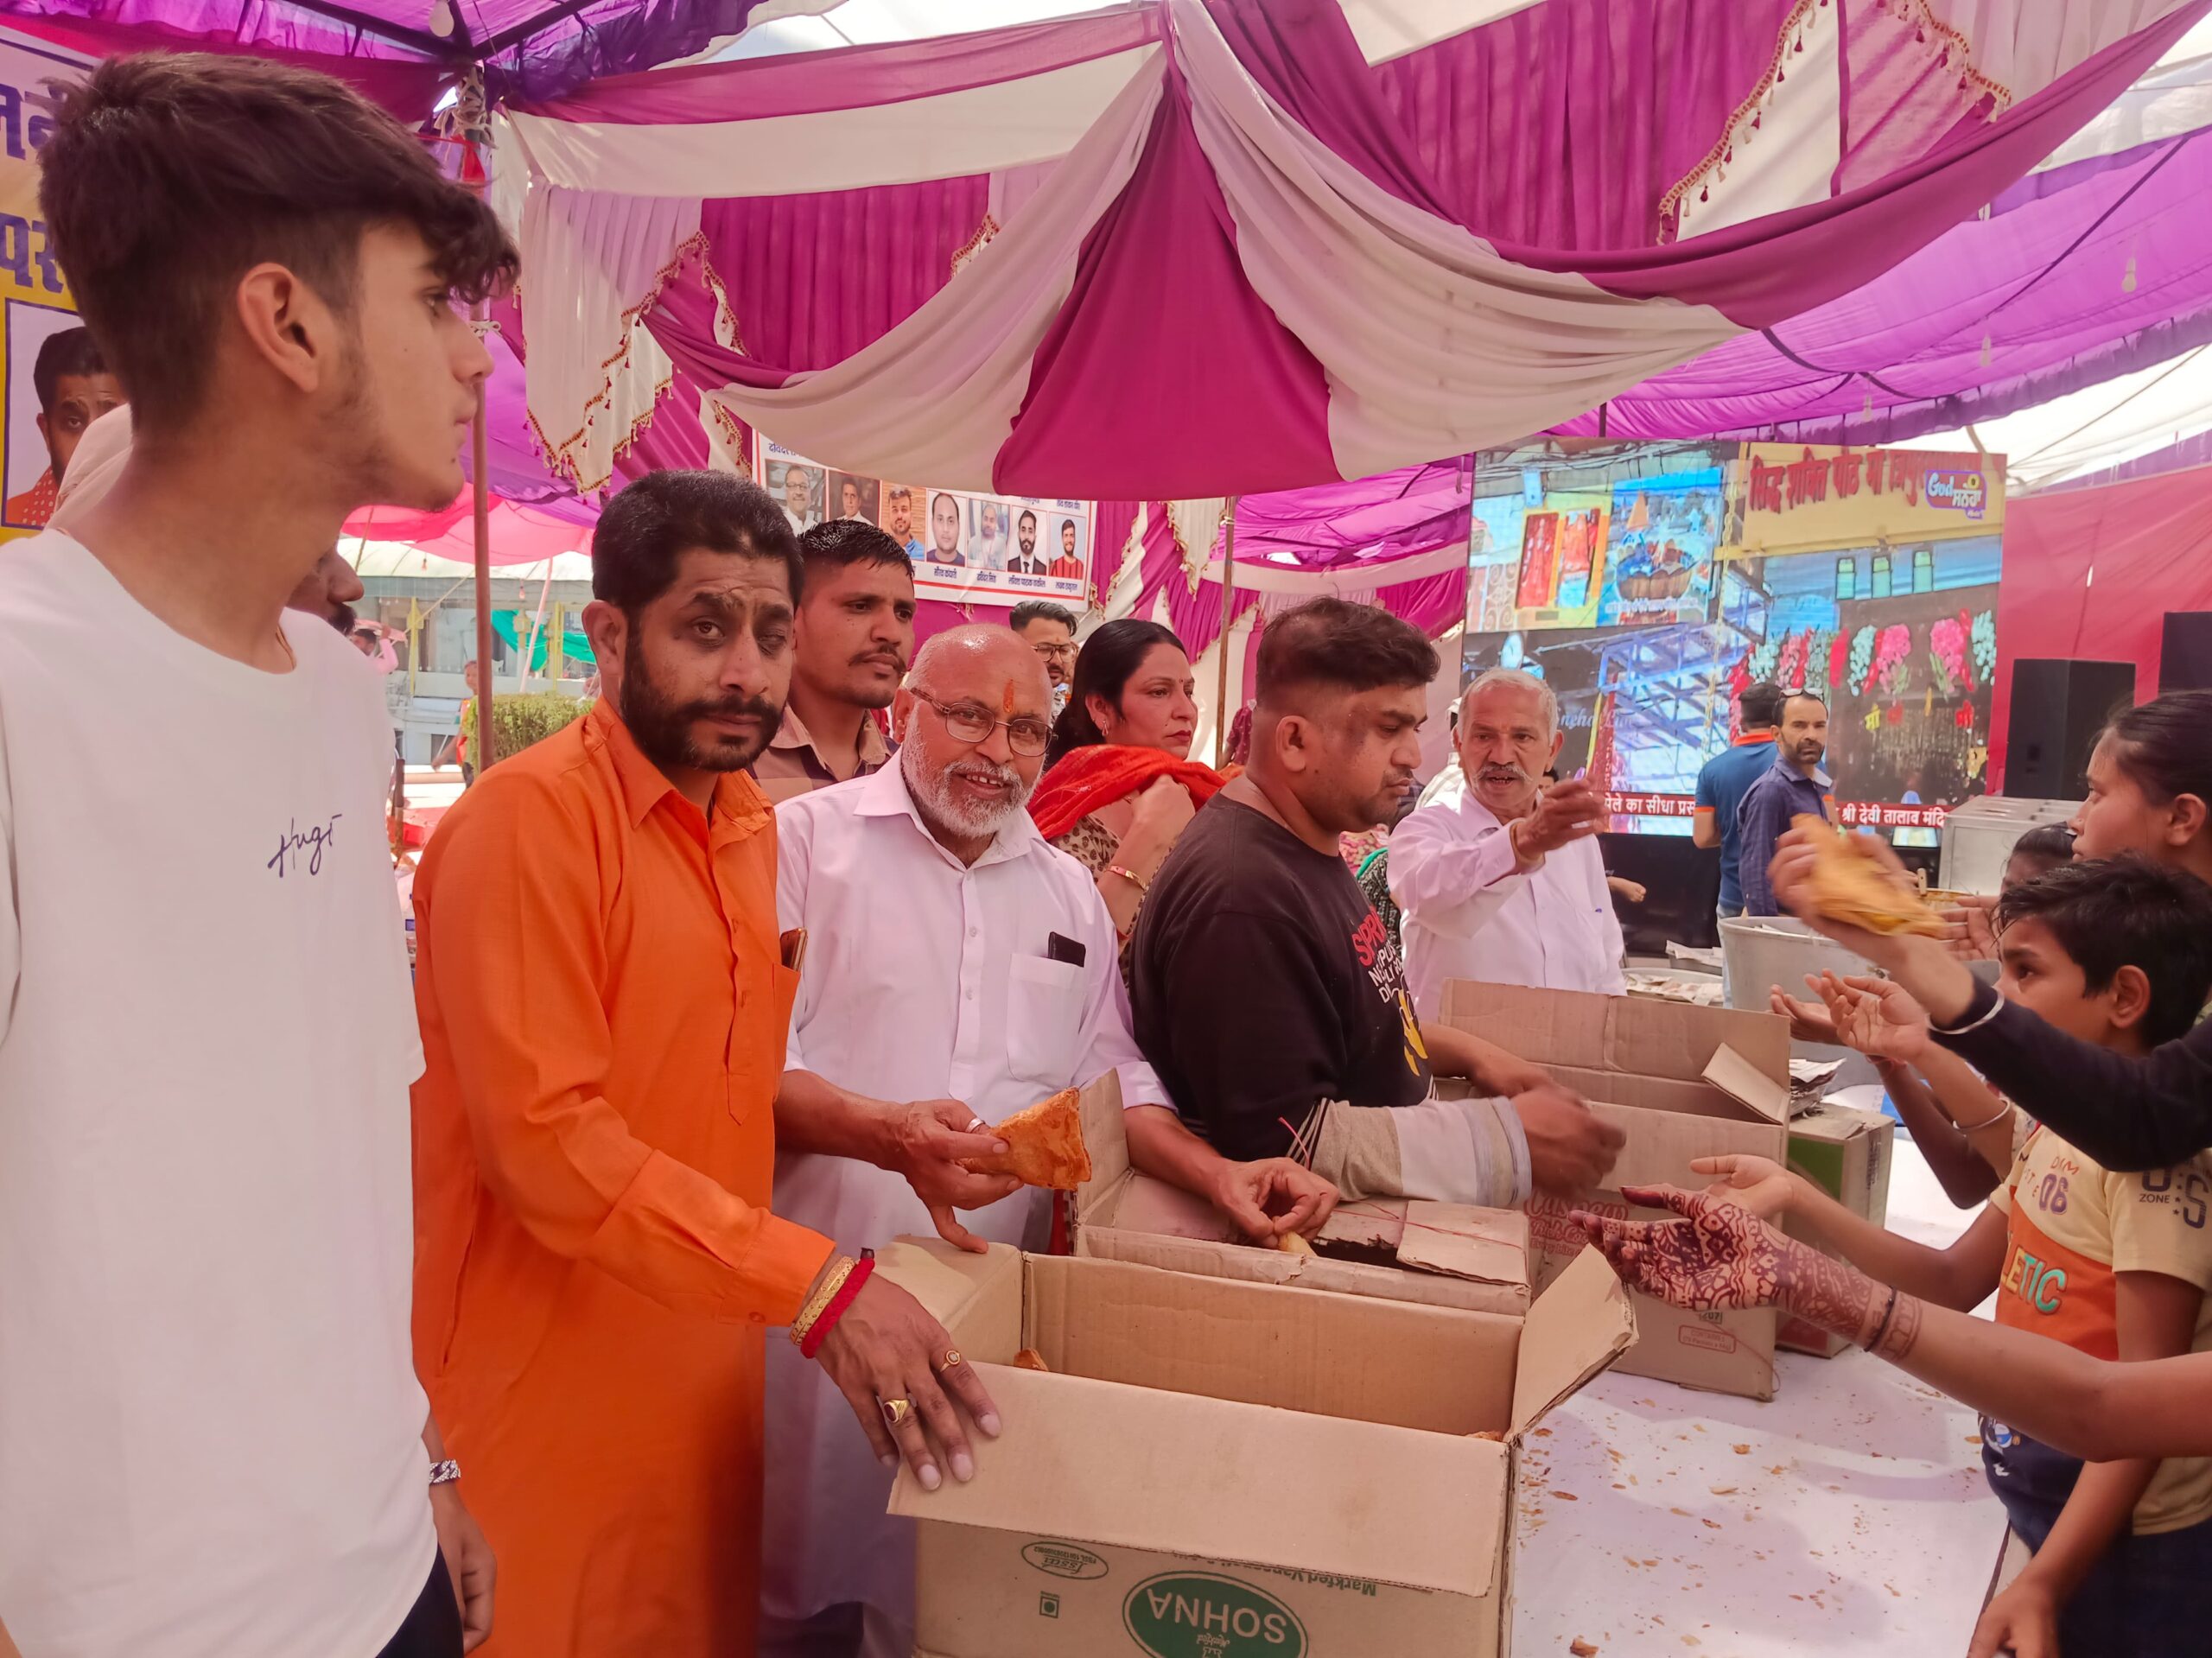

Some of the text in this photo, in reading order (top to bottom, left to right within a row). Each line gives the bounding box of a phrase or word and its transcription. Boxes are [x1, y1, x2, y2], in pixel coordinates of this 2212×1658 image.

[1625, 797, 1643, 813] का
[1645, 795, 1675, 815] सीधा
[1677, 800, 1695, 816] प्रस
[1841, 803, 1857, 823] श्री
[1859, 803, 1881, 824] देवी
[1922, 806, 1948, 828] मंदि
[2139, 1193, 2171, 1204] ZONE
[2000, 1245, 2068, 1316] ETIC
[1146, 1588, 1287, 1644] SOHNA
